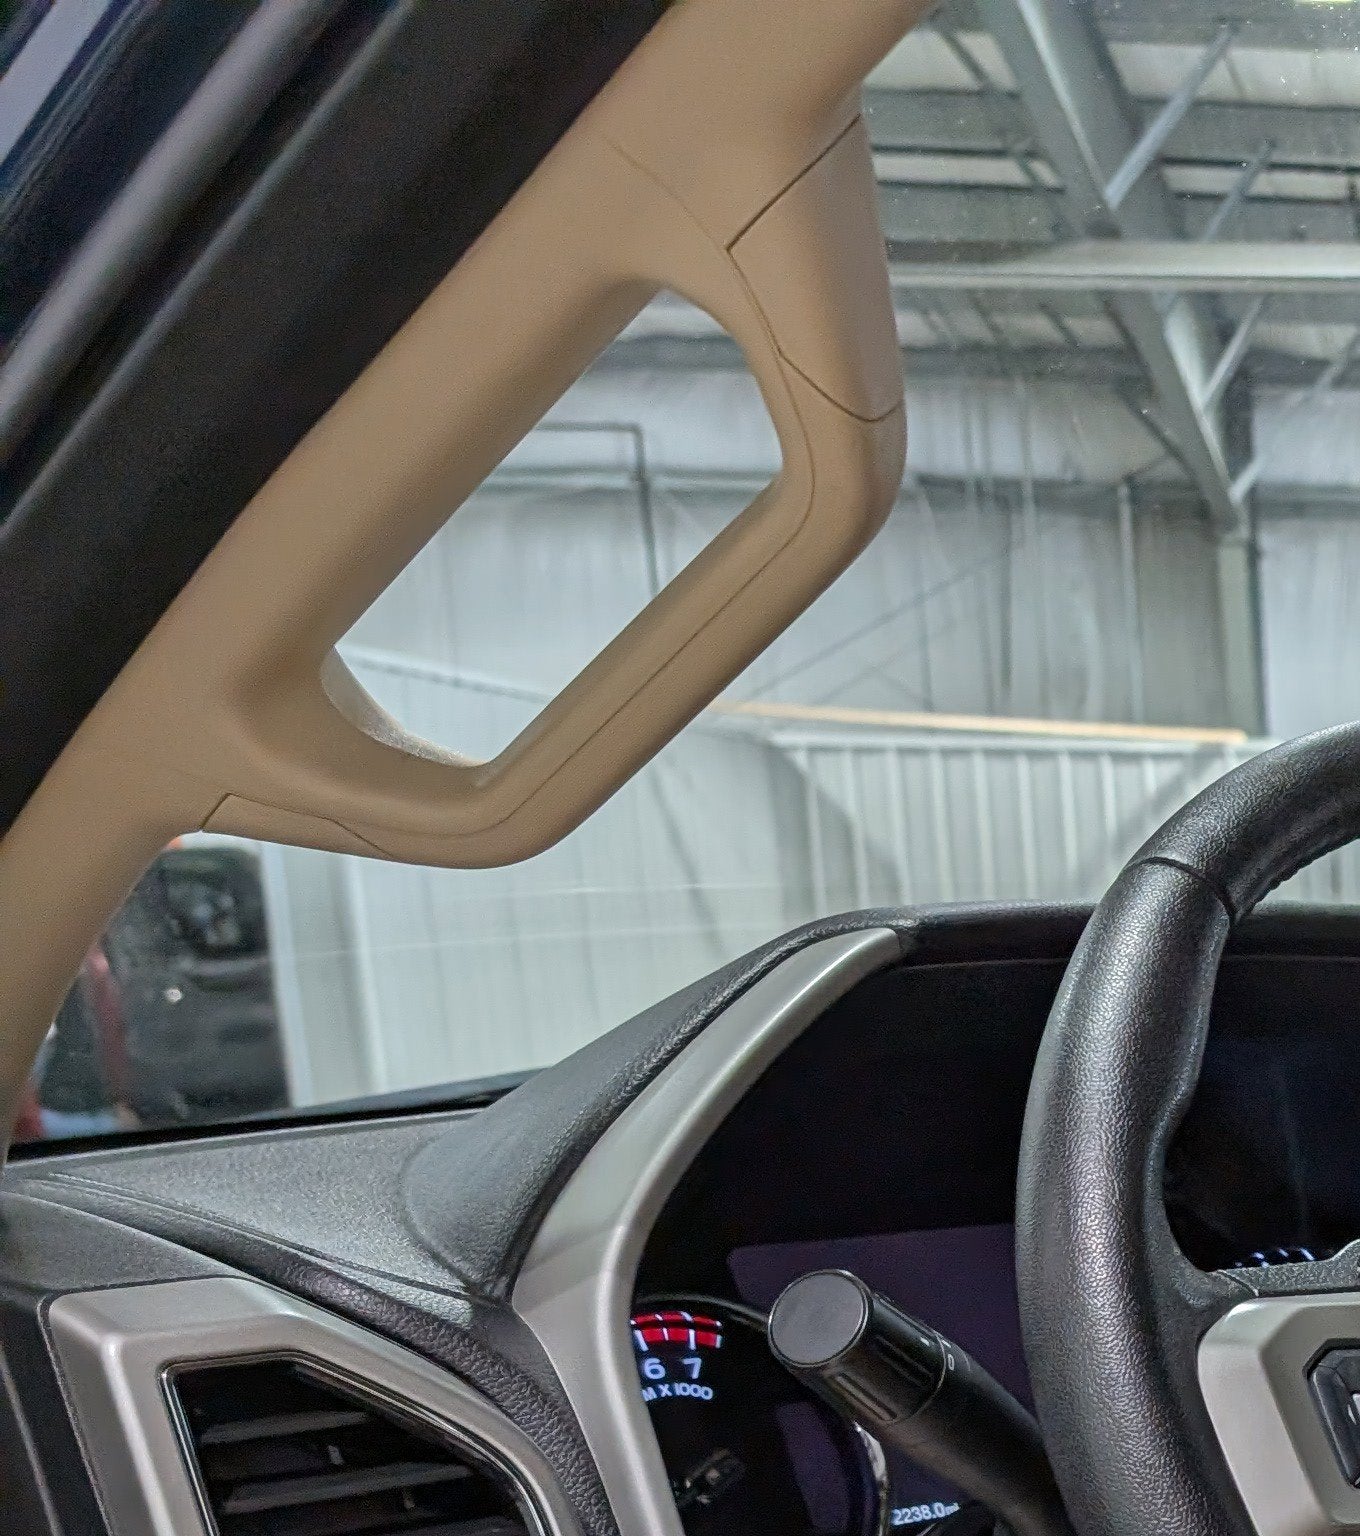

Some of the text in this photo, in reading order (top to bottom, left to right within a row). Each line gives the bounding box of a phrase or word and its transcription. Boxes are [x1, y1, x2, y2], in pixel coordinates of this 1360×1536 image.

[643, 1357, 667, 1380] 6
[682, 1357, 702, 1380] 7
[674, 1382, 714, 1401] 1000
